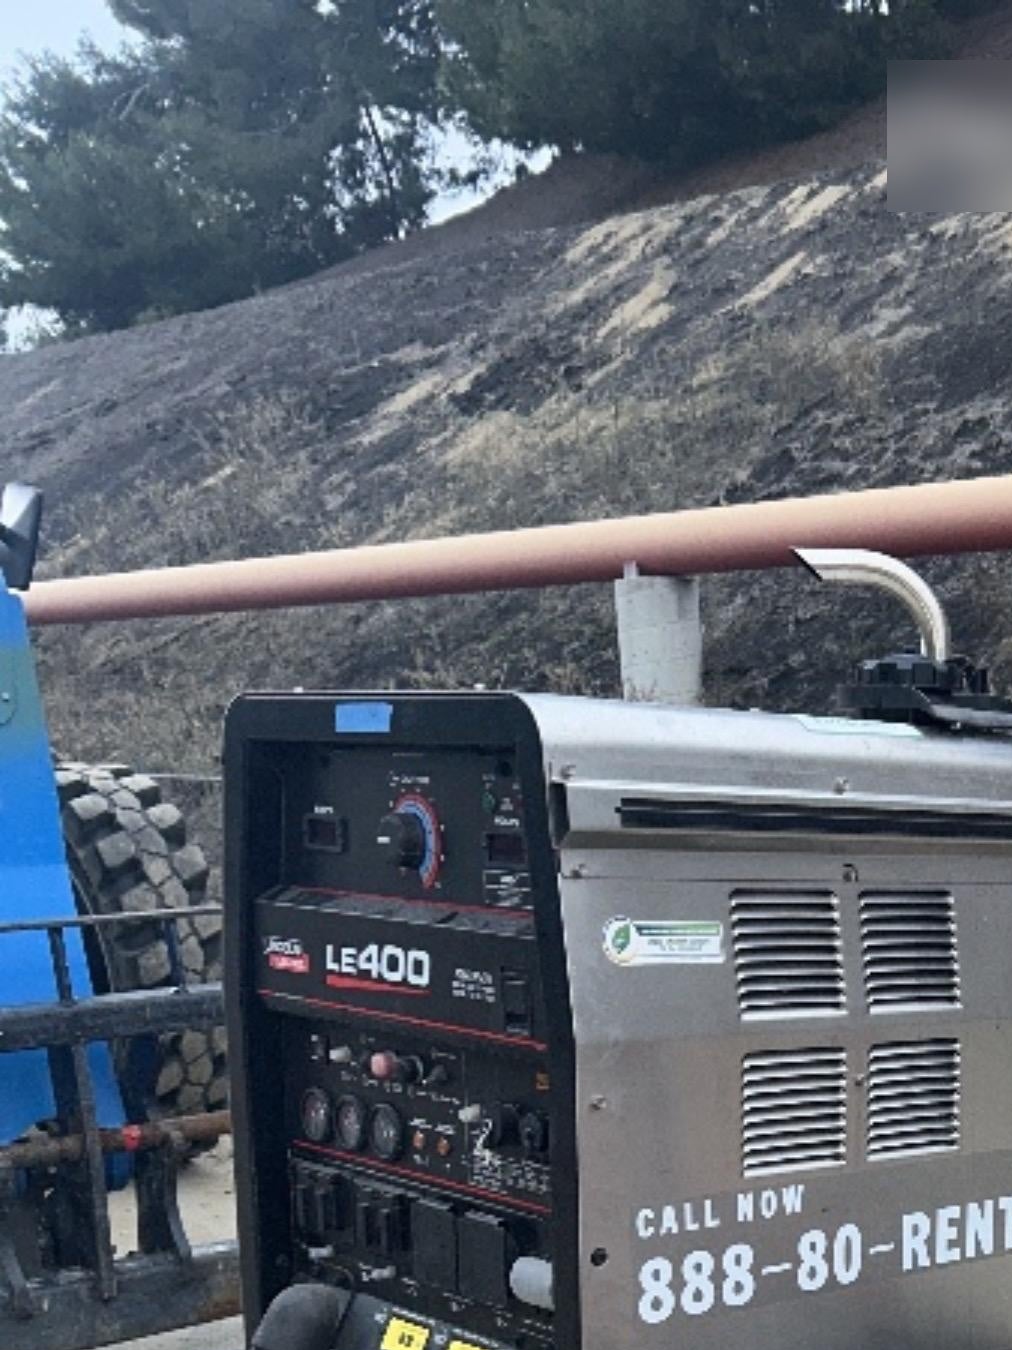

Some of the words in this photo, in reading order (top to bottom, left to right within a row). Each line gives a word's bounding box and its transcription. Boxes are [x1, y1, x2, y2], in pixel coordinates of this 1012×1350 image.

[325, 942, 431, 987] LE400
[636, 1199, 720, 1239] CALL
[737, 1184, 806, 1222] NOW
